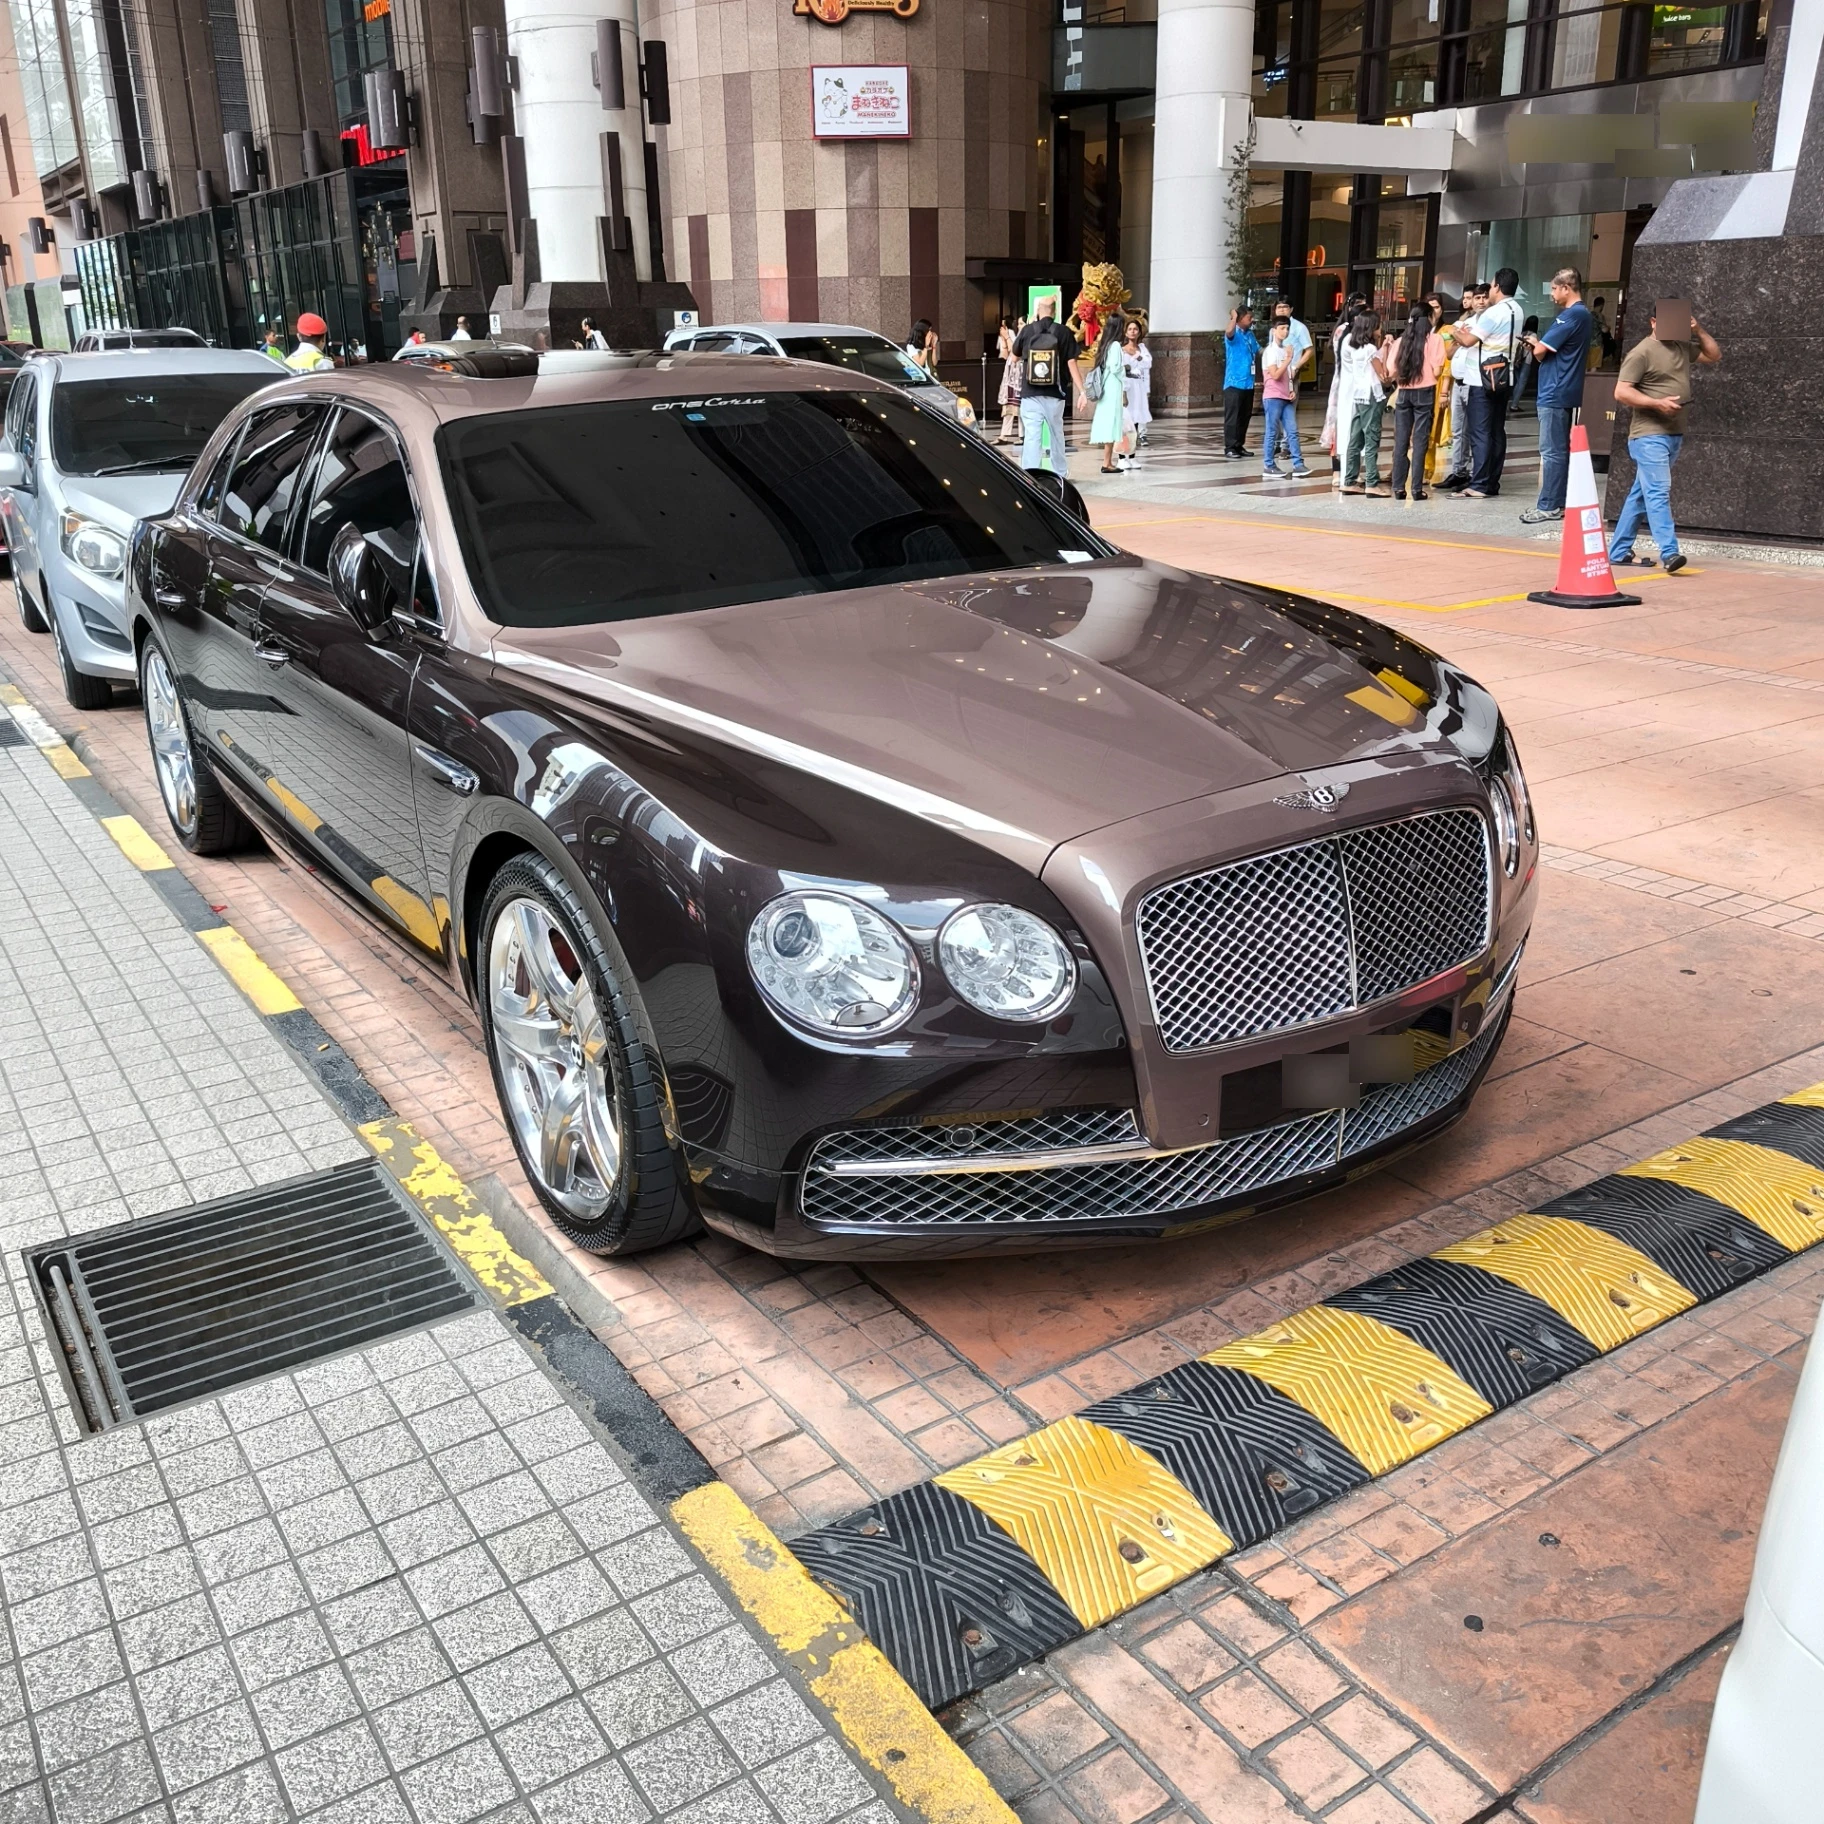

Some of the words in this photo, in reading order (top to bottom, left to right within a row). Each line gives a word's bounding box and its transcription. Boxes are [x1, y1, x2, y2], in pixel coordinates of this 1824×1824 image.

[851, 94, 901, 111] まねきねこ
